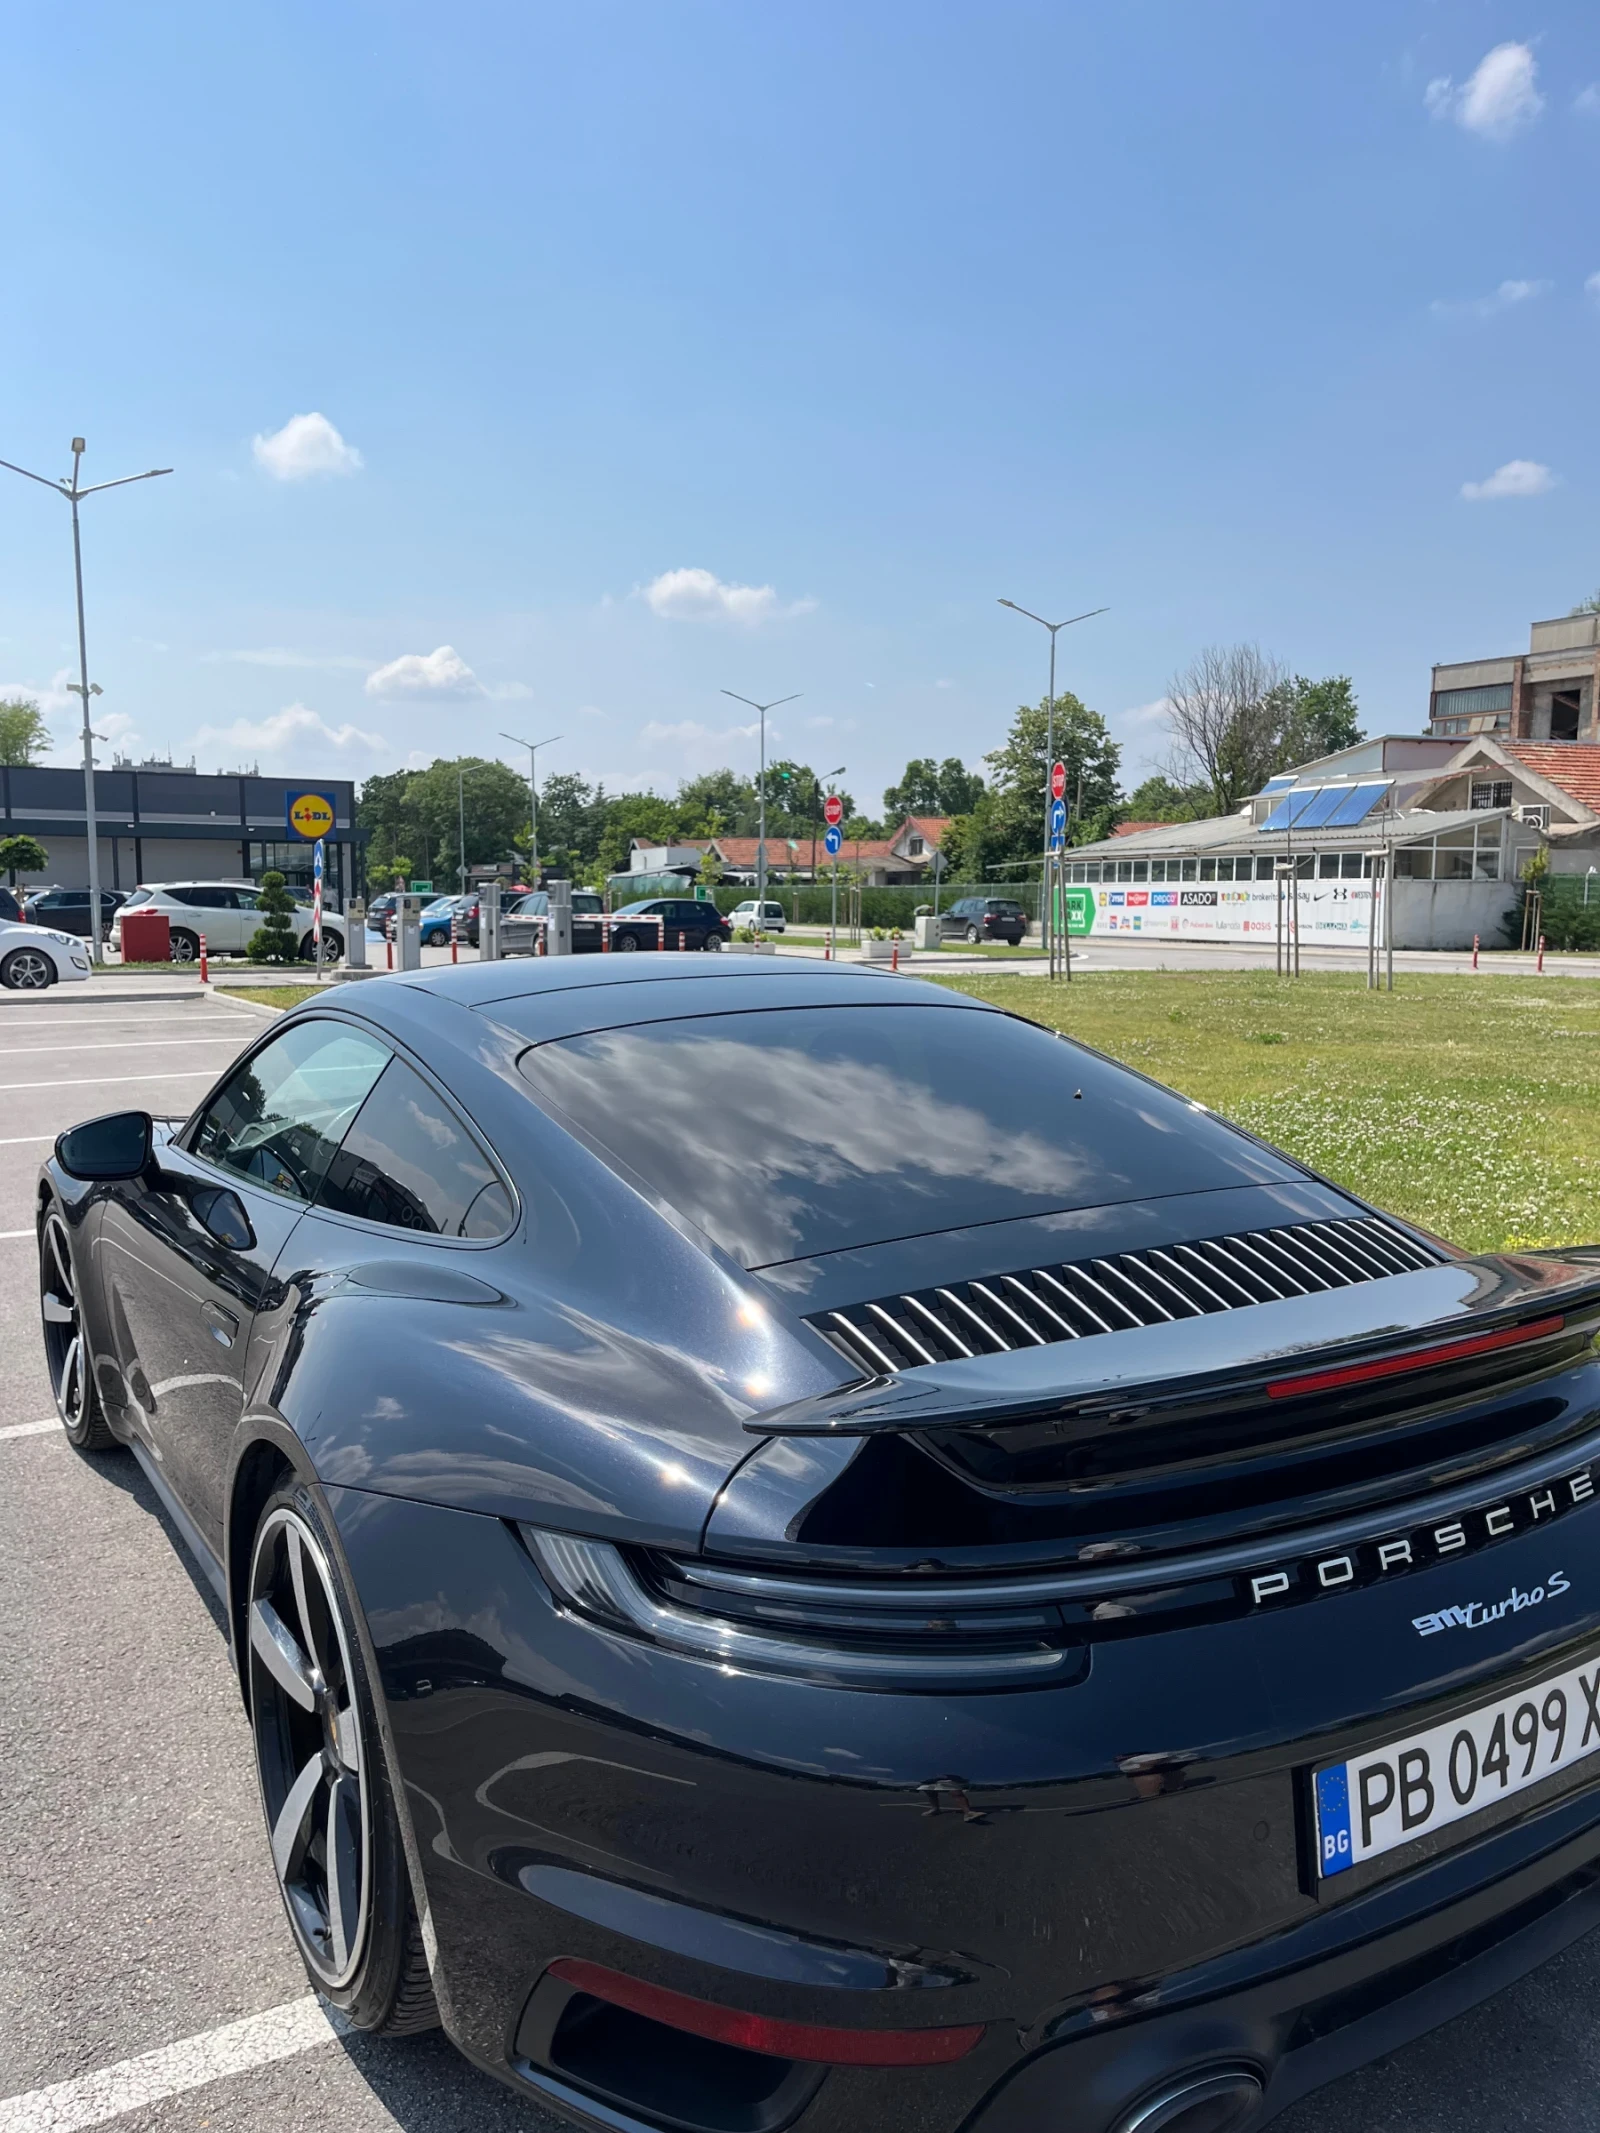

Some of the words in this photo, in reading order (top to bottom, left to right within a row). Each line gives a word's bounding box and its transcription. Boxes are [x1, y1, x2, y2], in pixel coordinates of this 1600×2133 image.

[1052, 775, 1064, 787] STOP
[294, 808, 331, 821] LIDL
[826, 805, 841, 815] STOP
[1066, 900, 1082, 910] ARK
[1153, 894, 1175, 904] pepco
[1182, 892, 1212, 905] ASADO
[1251, 1473, 1595, 1604] PORSCHE
[1358, 1747, 1435, 1848] PB
[1448, 1688, 1568, 1806] 0499
[1324, 1829, 1349, 1860] BG
